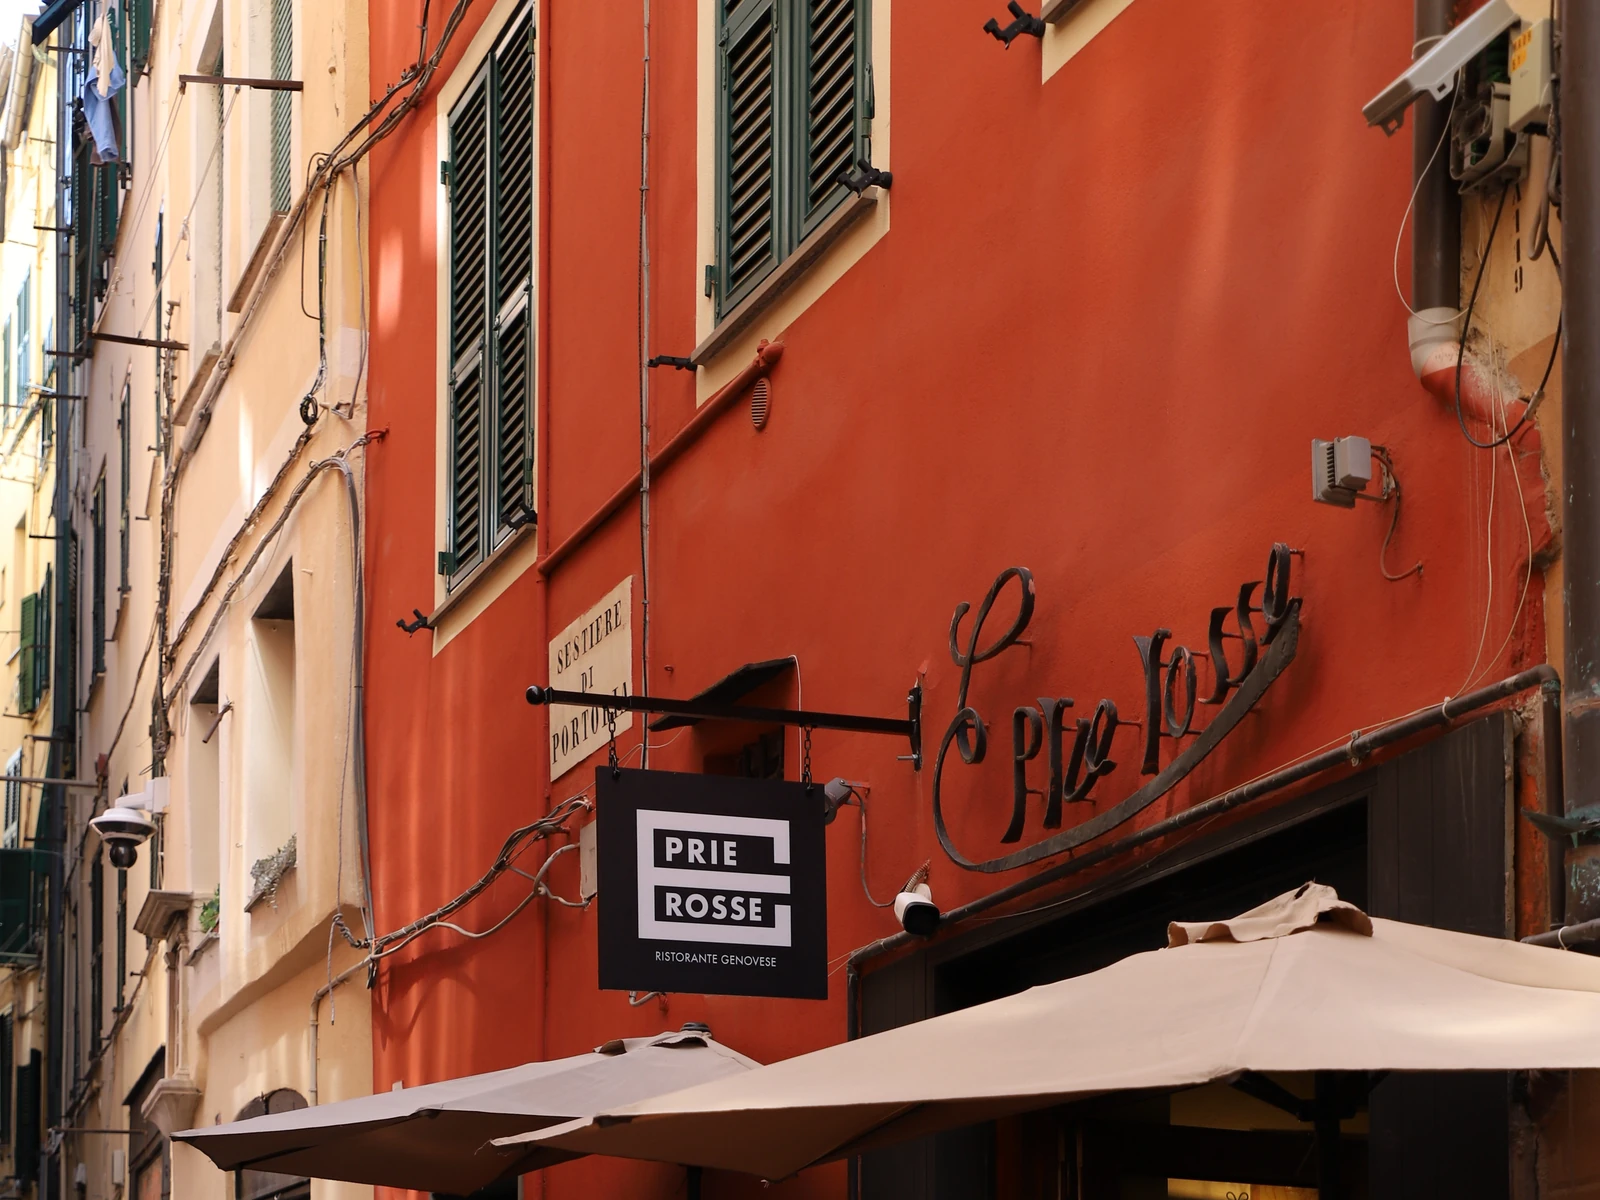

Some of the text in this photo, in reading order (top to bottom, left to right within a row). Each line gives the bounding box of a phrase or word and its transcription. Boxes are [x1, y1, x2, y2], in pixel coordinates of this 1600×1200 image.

[556, 600, 622, 675] SESTIERE
[580, 665, 595, 694] DI
[665, 836, 737, 866] PRIE
[665, 892, 763, 922] ROSSE
[655, 951, 777, 967] RISTORANTE GENOVESE
